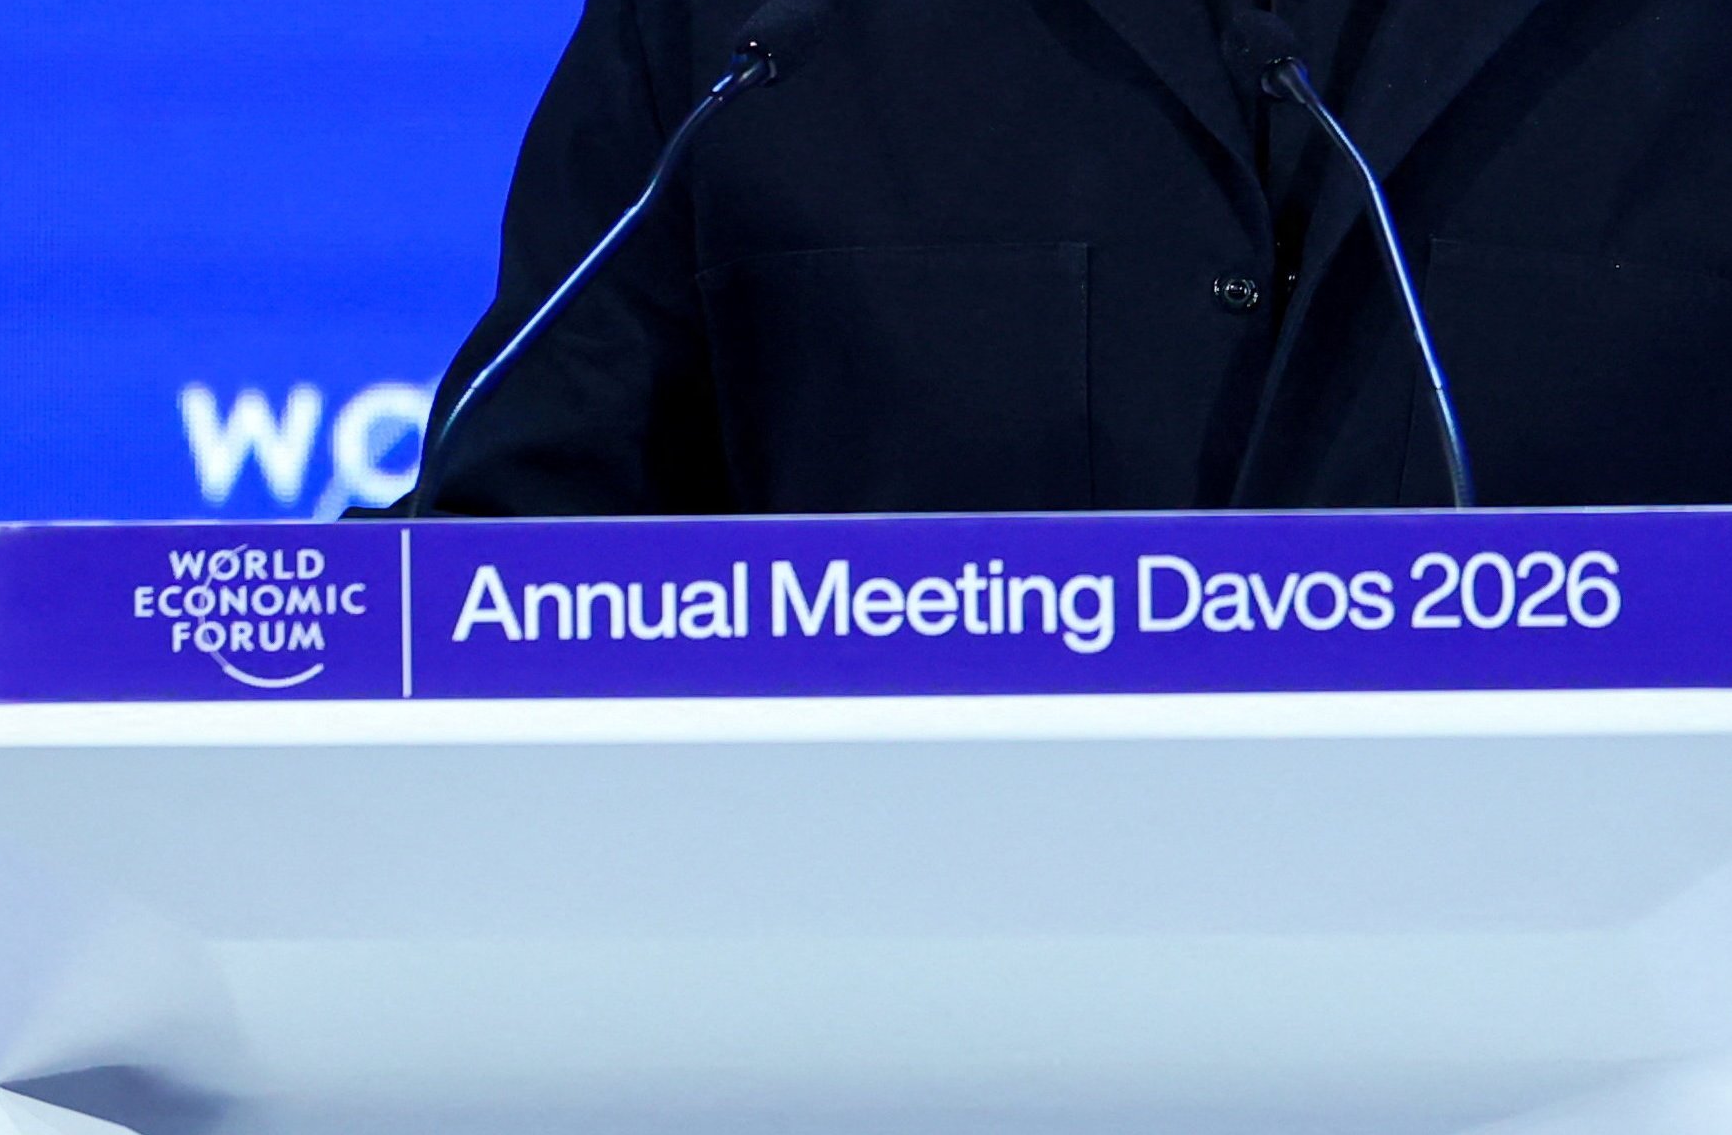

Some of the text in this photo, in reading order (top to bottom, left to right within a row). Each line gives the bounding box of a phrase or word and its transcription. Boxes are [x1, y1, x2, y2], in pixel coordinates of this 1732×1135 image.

[168, 548, 326, 581] WORLD
[133, 582, 367, 618] ECONOMIC
[450, 549, 1622, 655] Annual Meeting Davos 2026
[171, 620, 326, 653] FORUM
